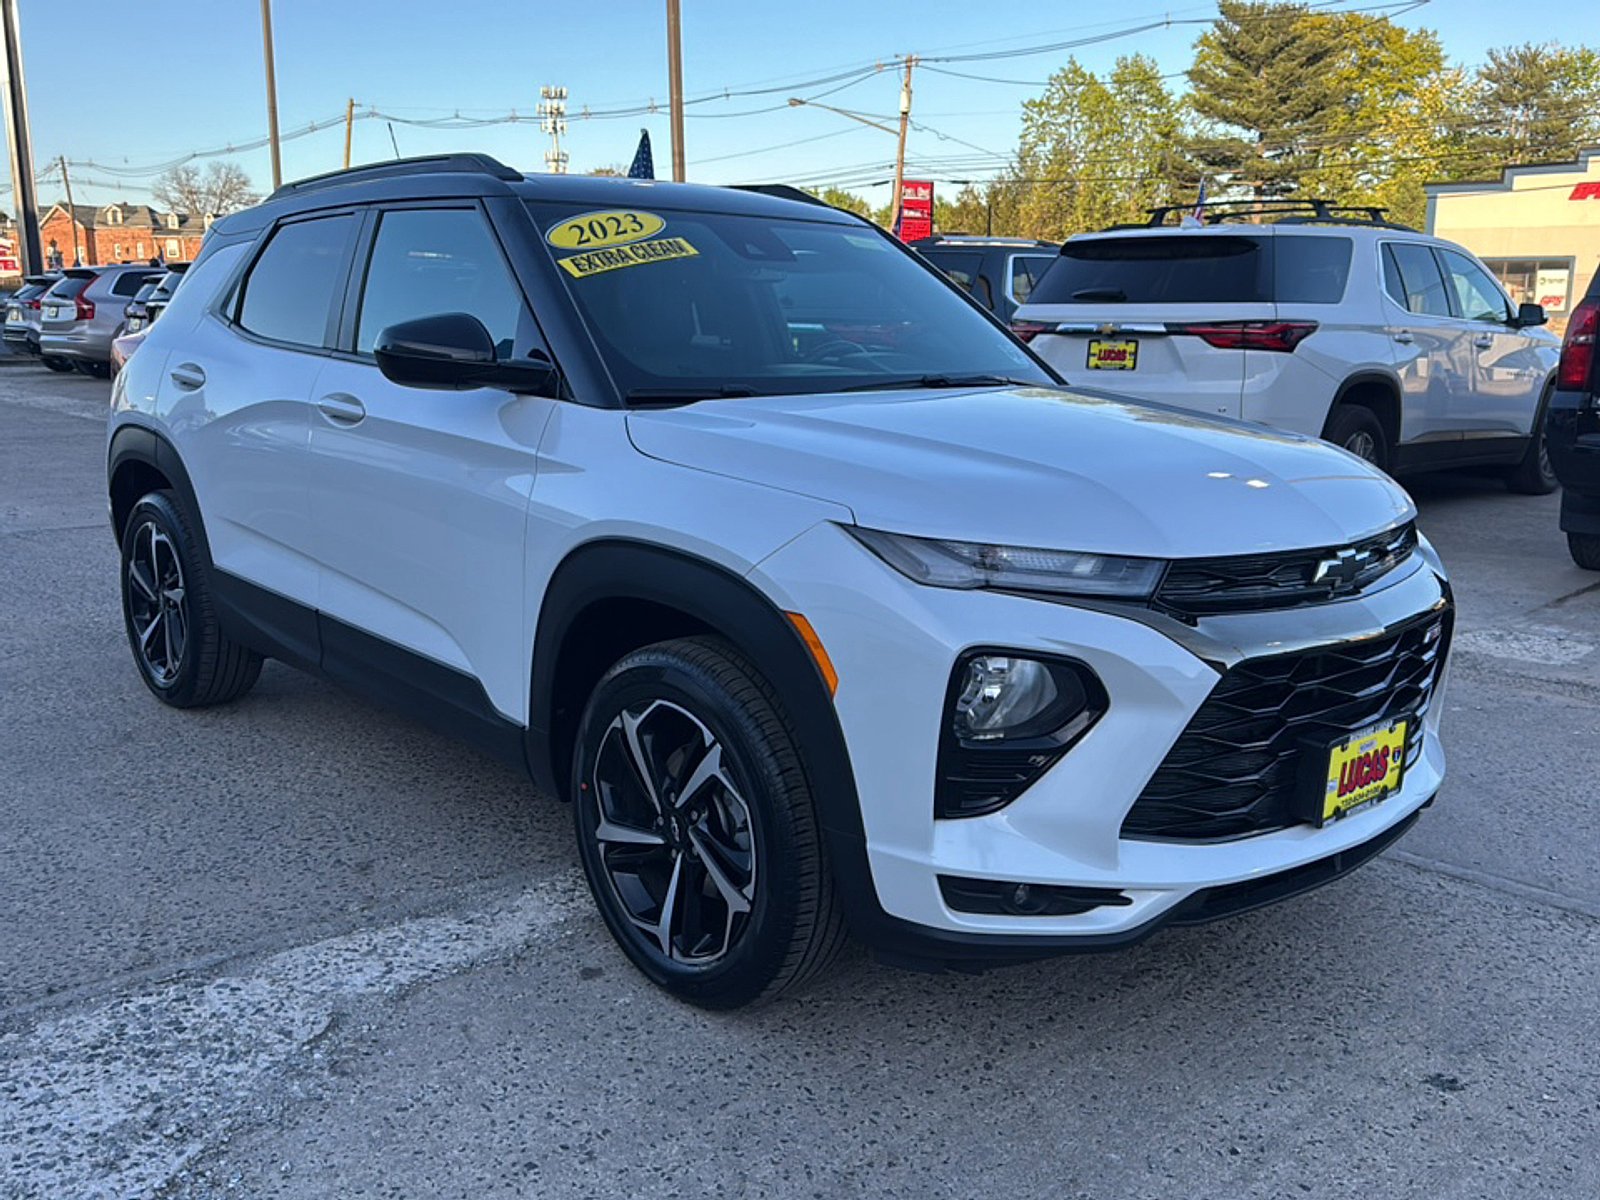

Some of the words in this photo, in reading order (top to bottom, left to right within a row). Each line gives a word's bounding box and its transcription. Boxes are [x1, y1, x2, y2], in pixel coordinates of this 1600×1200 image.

[569, 213, 644, 245] 2023
[570, 248, 634, 272] EXTRA
[630, 239, 687, 260] CLEAN
[1097, 349, 1127, 361] LUCAS
[1337, 745, 1389, 797] LUCAS
